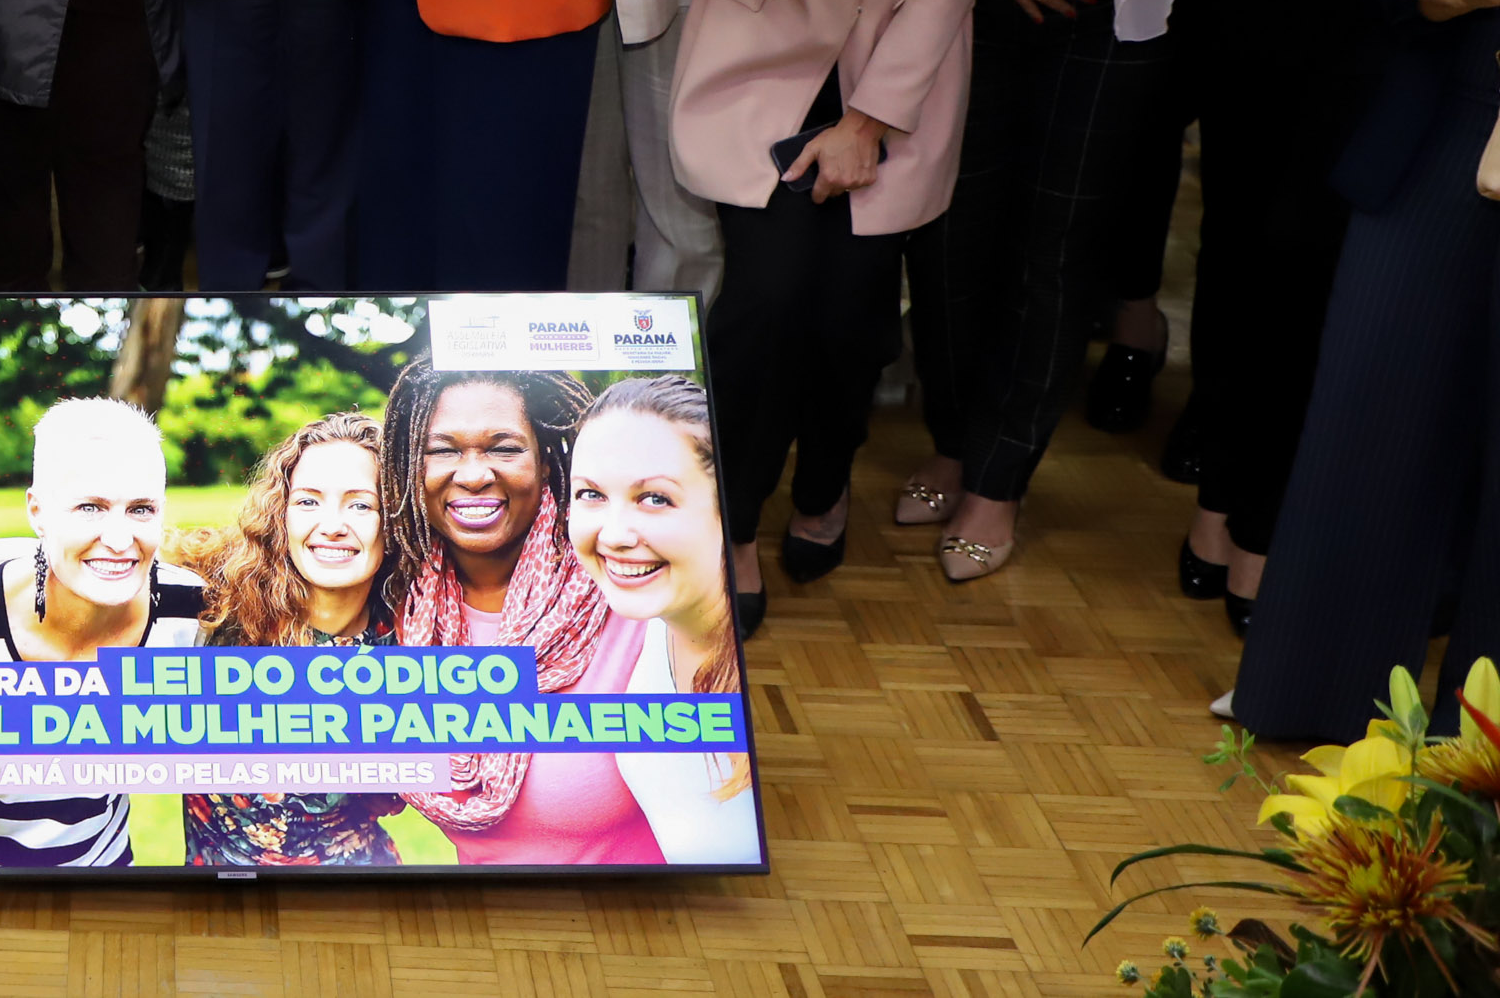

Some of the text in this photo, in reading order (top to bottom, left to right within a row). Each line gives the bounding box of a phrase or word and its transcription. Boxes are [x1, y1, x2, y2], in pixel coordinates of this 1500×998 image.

[528, 320, 591, 333] PARANÁ
[530, 342, 593, 352] MULHERES
[614, 331, 677, 345] PARANÁ
[54, 667, 110, 697] DA
[121, 655, 202, 696] LEI
[214, 654, 295, 696] DO
[306, 645, 519, 696] CÓDIGO
[33, 704, 110, 746] DA
[123, 702, 348, 745] MULHER
[361, 702, 735, 745] PARANAENSE
[71, 763, 168, 786] UNIDO
[176, 762, 269, 786] PELAS
[276, 760, 436, 785] MULHERES
